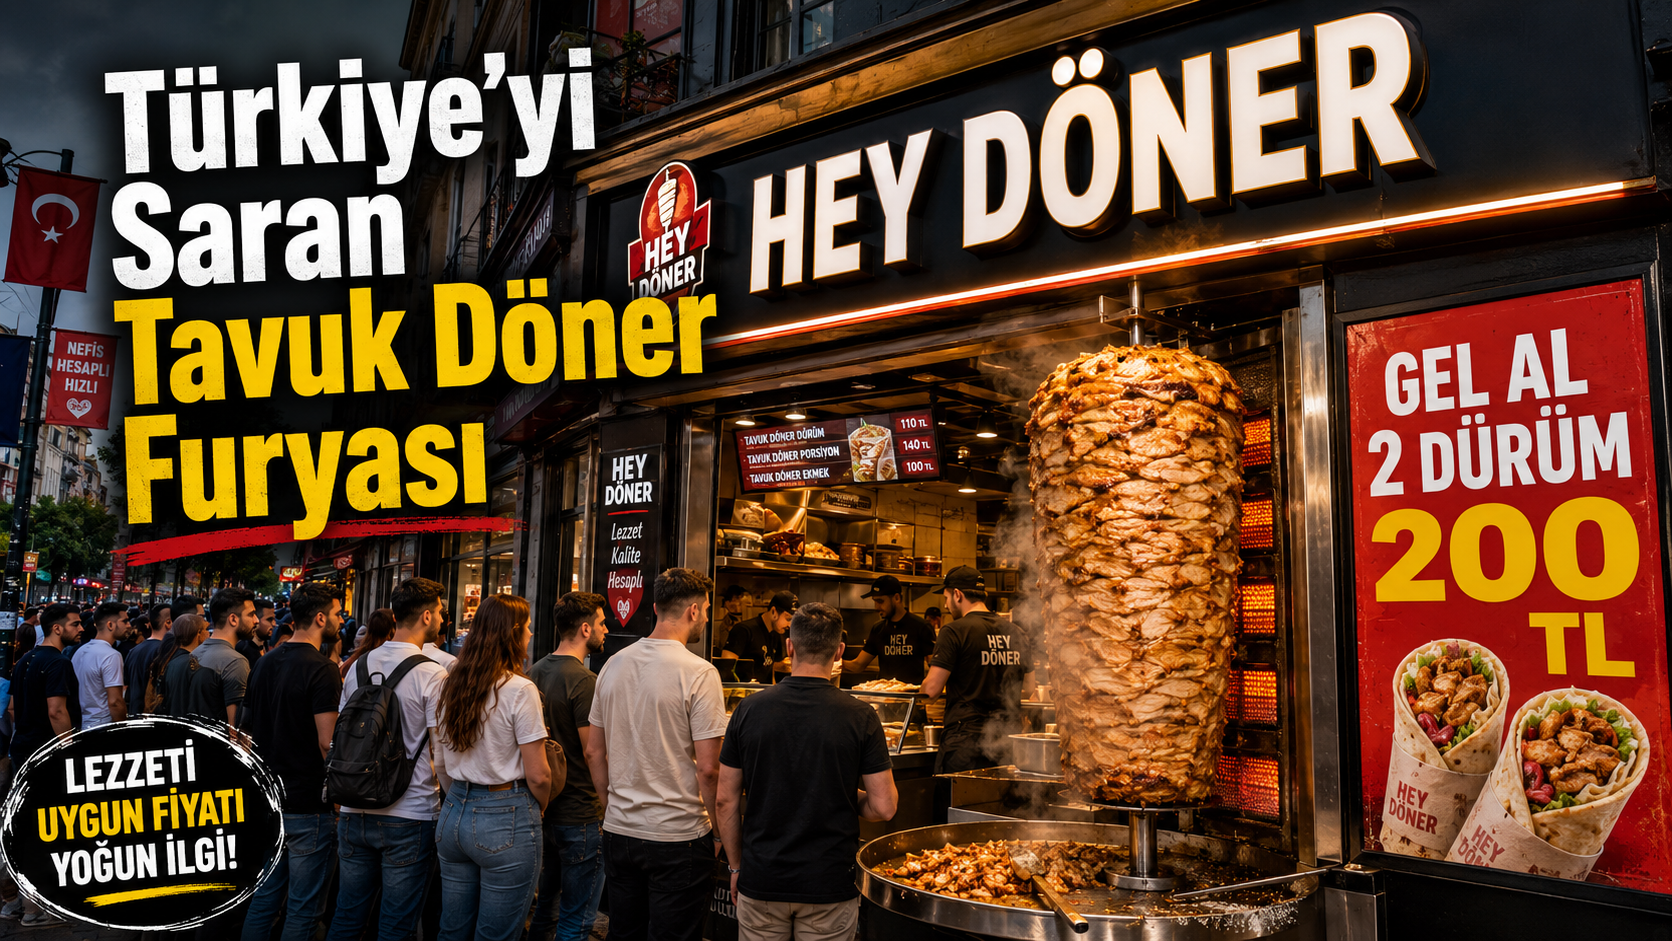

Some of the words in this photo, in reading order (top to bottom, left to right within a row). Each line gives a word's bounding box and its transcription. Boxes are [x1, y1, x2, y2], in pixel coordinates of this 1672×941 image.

[750, 130, 933, 294] HEY
[963, 12, 1419, 249] DÖNER
[645, 220, 691, 273] HEY
[639, 255, 697, 298] DÖNER
[67, 341, 105, 358] NEFİS
[57, 358, 110, 377] HESAPLI
[1384, 342, 1490, 418] GEL
[1506, 328, 1589, 404] AL
[65, 378, 98, 394] HIZLI
[901, 418, 917, 429] 110
[918, 419, 928, 427] TL
[744, 434, 769, 446] TAVUK
[903, 439, 920, 450] 140
[921, 441, 931, 449] TL
[746, 453, 772, 465] TAVUK
[1367, 429, 1405, 497] 2
[1420, 404, 1633, 491] DÜRÜM
[612, 453, 649, 482] HEY
[749, 473, 774, 484] TAVUK
[803, 467, 830, 480] EKMEK
[906, 461, 923, 472] 100
[605, 479, 653, 506] DÖNER
[611, 521, 643, 541] Lezzet
[611, 545, 641, 565] Kalite
[1371, 496, 1640, 602] 200
[890, 634, 908, 645] HEY
[987, 634, 1011, 649] HEY
[1528, 612, 1636, 678] TL
[981, 648, 1021, 666] DÖNER
[1397, 780, 1429, 810] HEY
[1388, 797, 1438, 835] DÖNER
[1471, 824, 1505, 863] HEY
